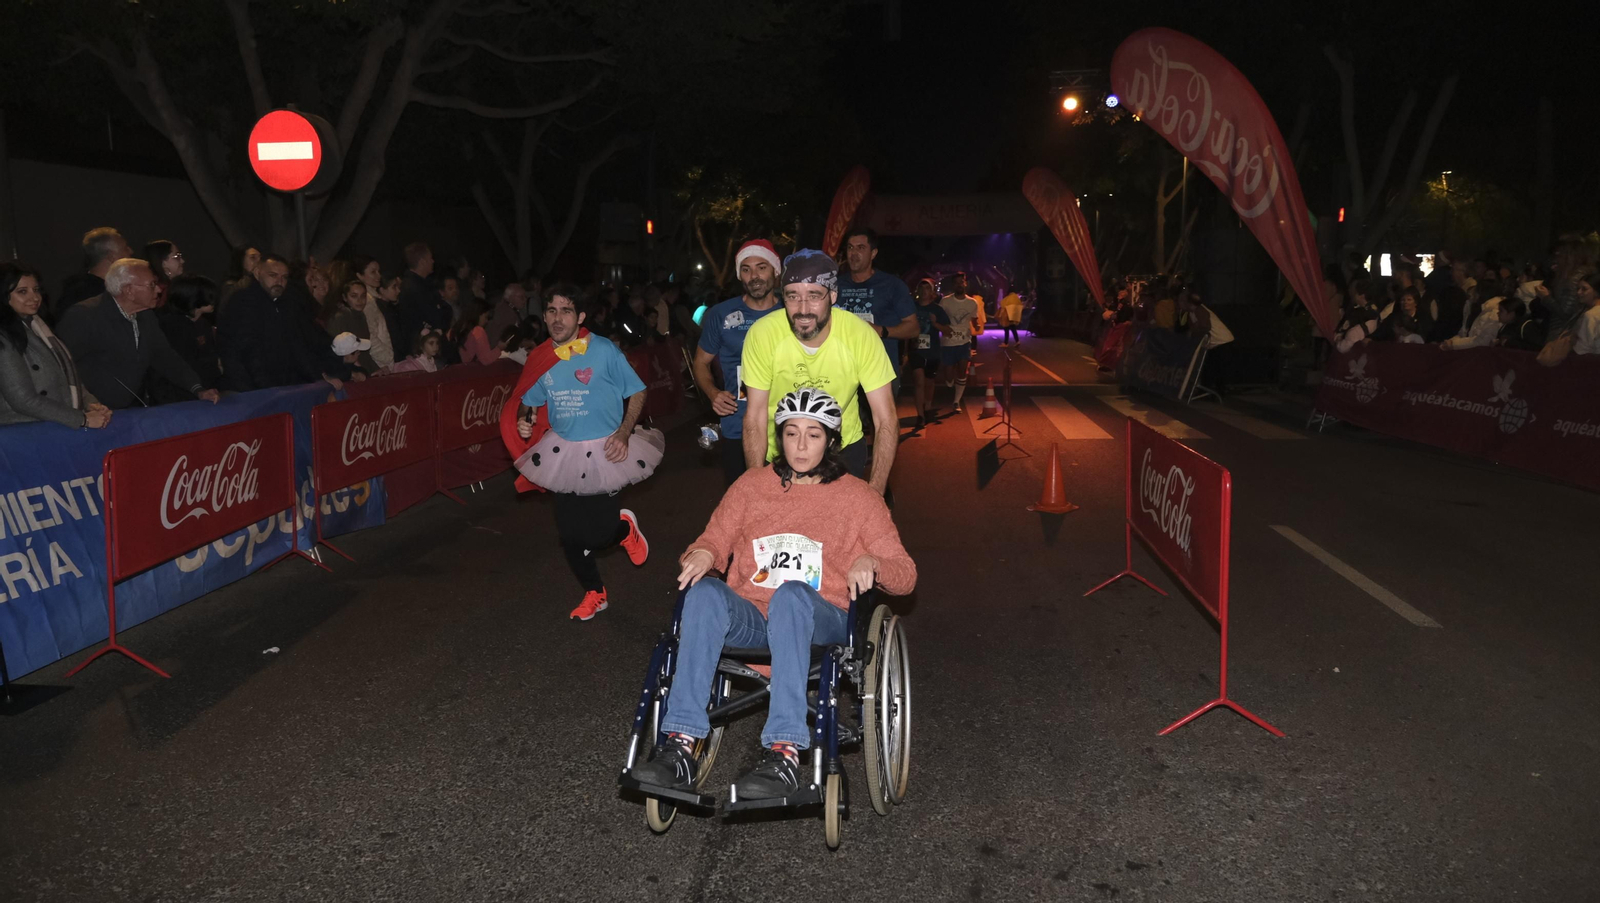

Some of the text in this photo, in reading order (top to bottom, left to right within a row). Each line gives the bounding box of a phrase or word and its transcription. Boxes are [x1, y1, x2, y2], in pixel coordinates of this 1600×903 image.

[341, 402, 409, 466] Coca-Cola
[461, 384, 512, 430] Coca-Col
[1402, 389, 1500, 418] aquéatacamos
[160, 437, 263, 530] Coca-Cola
[1140, 447, 1196, 554] Coca-Cola
[0, 537, 84, 604] RÍA
[770, 551, 802, 570] 821
